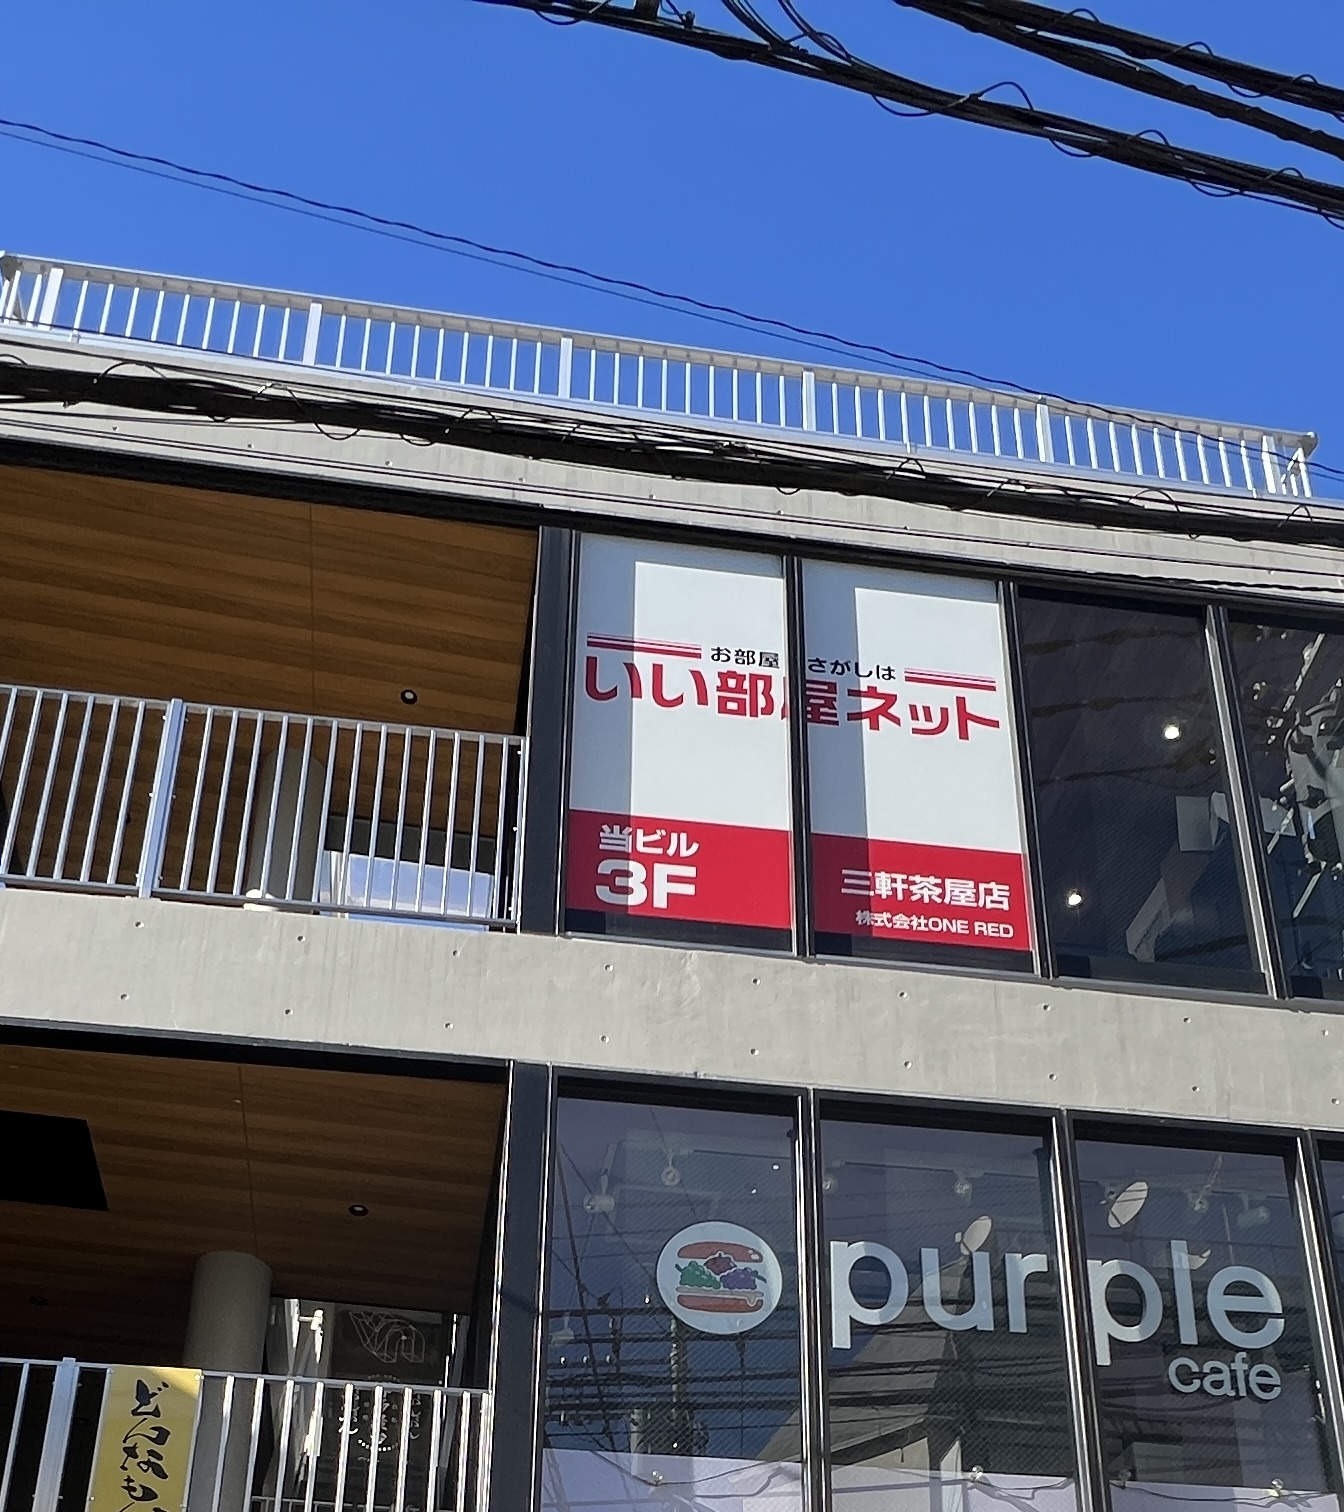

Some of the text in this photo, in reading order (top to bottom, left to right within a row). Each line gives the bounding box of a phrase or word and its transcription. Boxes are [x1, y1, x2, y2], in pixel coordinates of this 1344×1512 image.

[584, 655, 1000, 741] いい部屋ネット
[598, 824, 700, 857] 当ビル
[595, 858, 698, 910] 3F
[840, 868, 1011, 912] 三軒茶屋店
[974, 921, 1014, 939] RED
[829, 1238, 1287, 1367] purple
[1167, 1351, 1283, 1401] cafe
